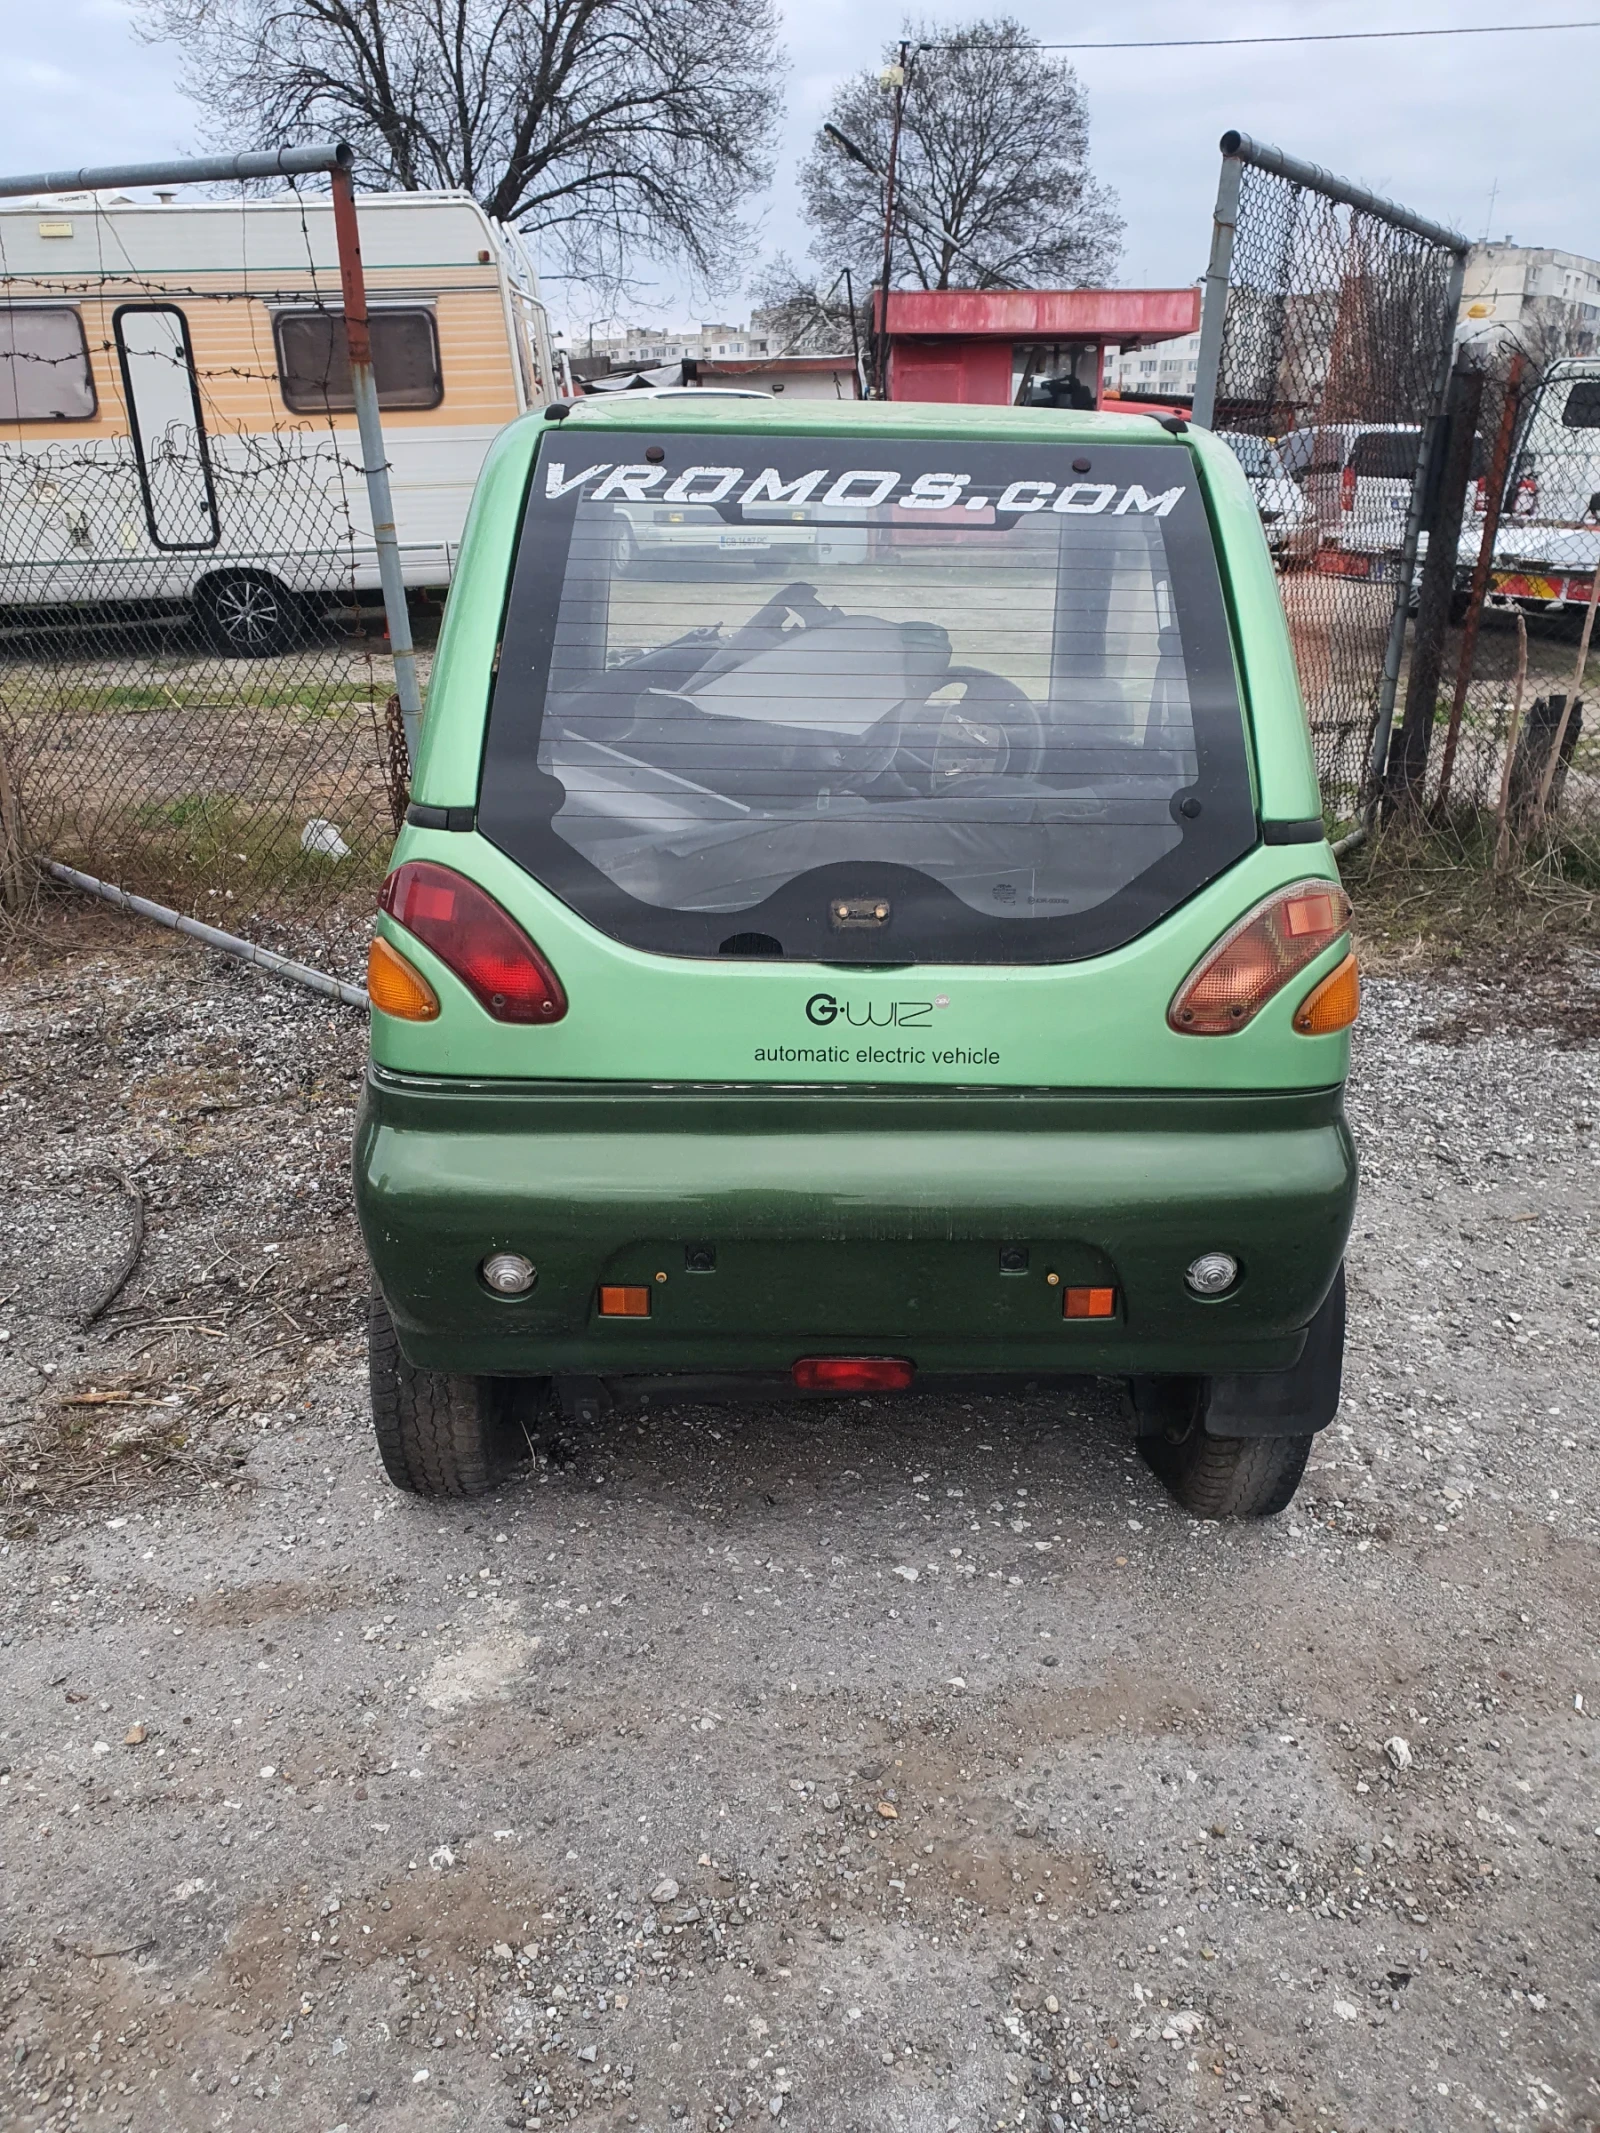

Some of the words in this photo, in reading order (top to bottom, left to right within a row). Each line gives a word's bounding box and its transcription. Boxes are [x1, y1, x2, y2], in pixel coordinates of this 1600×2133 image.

[545, 463, 1186, 517] VROMOS.COM
[754, 1046, 850, 1062] automatic
[856, 1046, 926, 1064] electric
[932, 1047, 1000, 1065] vehicle
